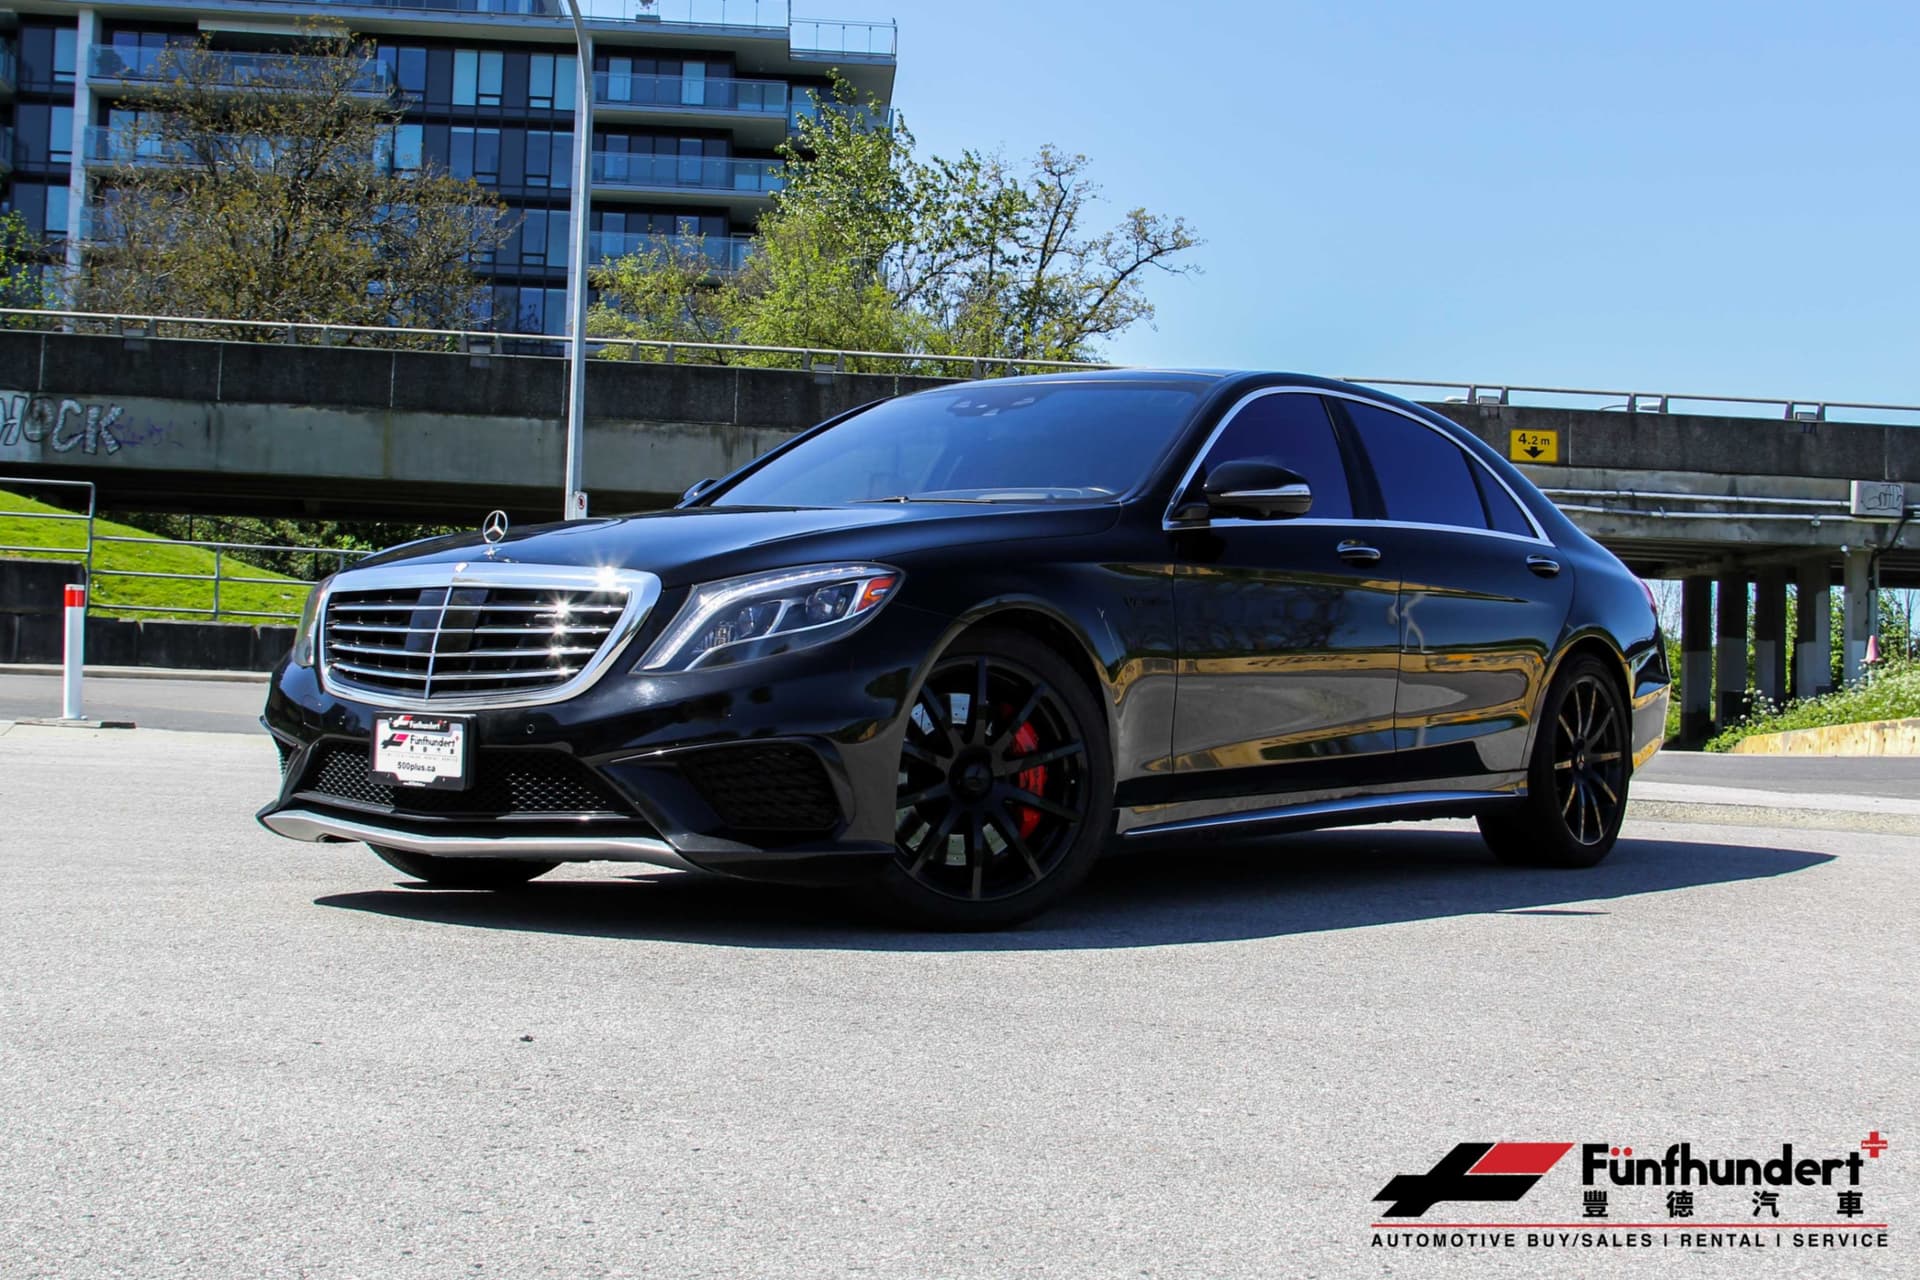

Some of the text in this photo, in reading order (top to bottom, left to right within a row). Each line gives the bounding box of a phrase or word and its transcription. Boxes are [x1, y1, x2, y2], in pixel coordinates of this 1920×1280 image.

[1518, 433, 1551, 446] 4.2 m
[397, 761, 436, 772] 500plus.ca
